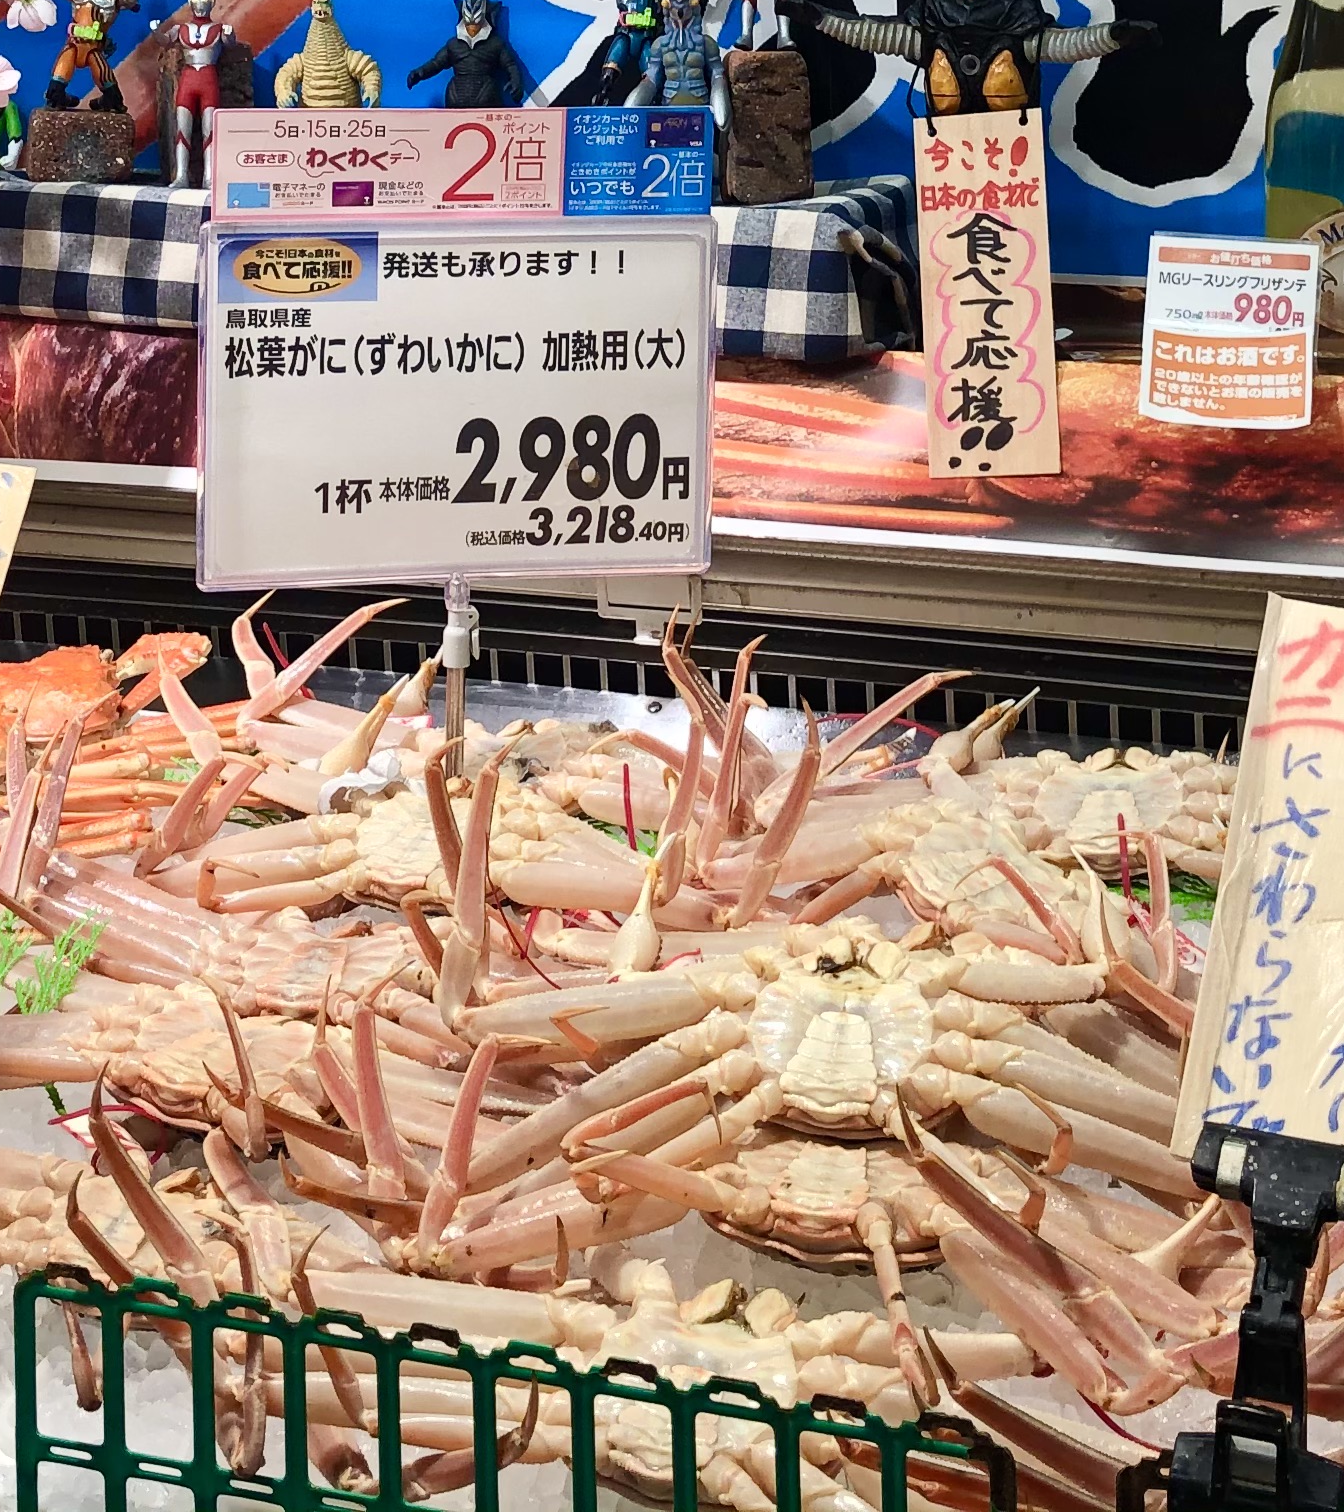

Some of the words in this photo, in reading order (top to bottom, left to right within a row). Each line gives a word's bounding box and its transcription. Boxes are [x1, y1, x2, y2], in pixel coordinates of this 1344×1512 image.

[273, 119, 387, 139] 5日・15日・25日
[502, 121, 551, 135] ポイント
[573, 114, 640, 125] イオンカードの
[573, 125, 638, 135] クレジット払い
[585, 135, 625, 146] ご利用で
[242, 152, 289, 165] お客さま
[305, 146, 415, 172] わくわくデー
[441, 121, 548, 203] 2倍
[924, 136, 1031, 179] 今こそ！
[272, 181, 327, 193] 電子マネーの
[377, 180, 424, 190] 現金などの
[641, 153, 706, 198] 2倍
[570, 180, 636, 196] いつでも
[919, 180, 1040, 213] 日本の食材で
[382, 249, 628, 279] 発送も承ります！！
[1210, 251, 1273, 267] お値打ち価格
[242, 259, 354, 283] 食べて応援!!
[1158, 270, 1308, 293] MGリースリングフリザンテ
[225, 308, 313, 330] 鳥取県産
[1234, 292, 1306, 328] 980円
[224, 332, 527, 379] 松葉がに（ずわいかに）
[541, 326, 688, 374] 加熱用（大）
[944, 211, 1019, 474] 食べて応援！！
[1154, 339, 1306, 367] これはお酒です。
[313, 479, 373, 515] 1杯
[378, 475, 452, 501] 本体価格
[451, 412, 692, 505] 2,980円
